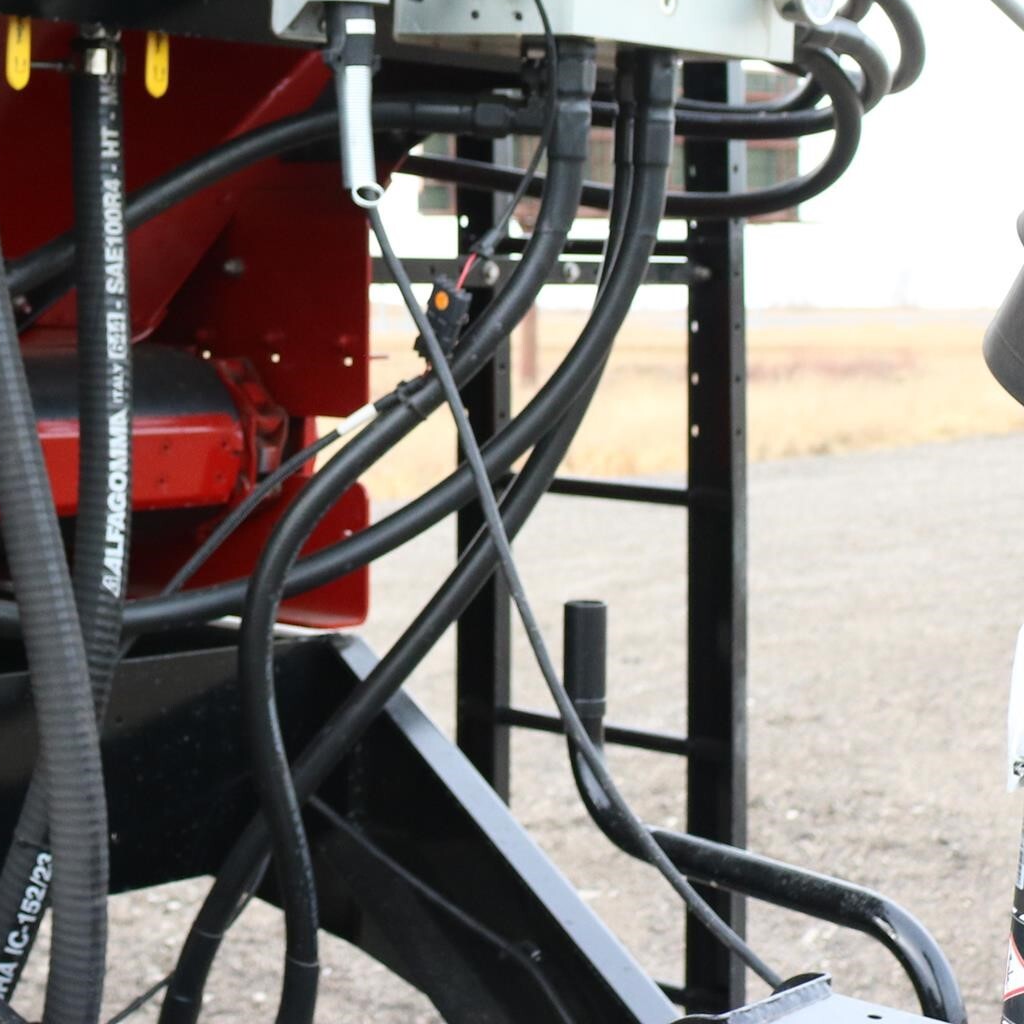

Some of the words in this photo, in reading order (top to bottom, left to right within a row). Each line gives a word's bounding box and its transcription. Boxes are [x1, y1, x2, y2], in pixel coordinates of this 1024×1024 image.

[100, 125, 120, 158] HT
[102, 178, 125, 295] SAE100R4
[112, 363, 124, 404] ITALY
[103, 408, 128, 576] ALFAGOMMA
[4, 852, 53, 956] IC-152/23
